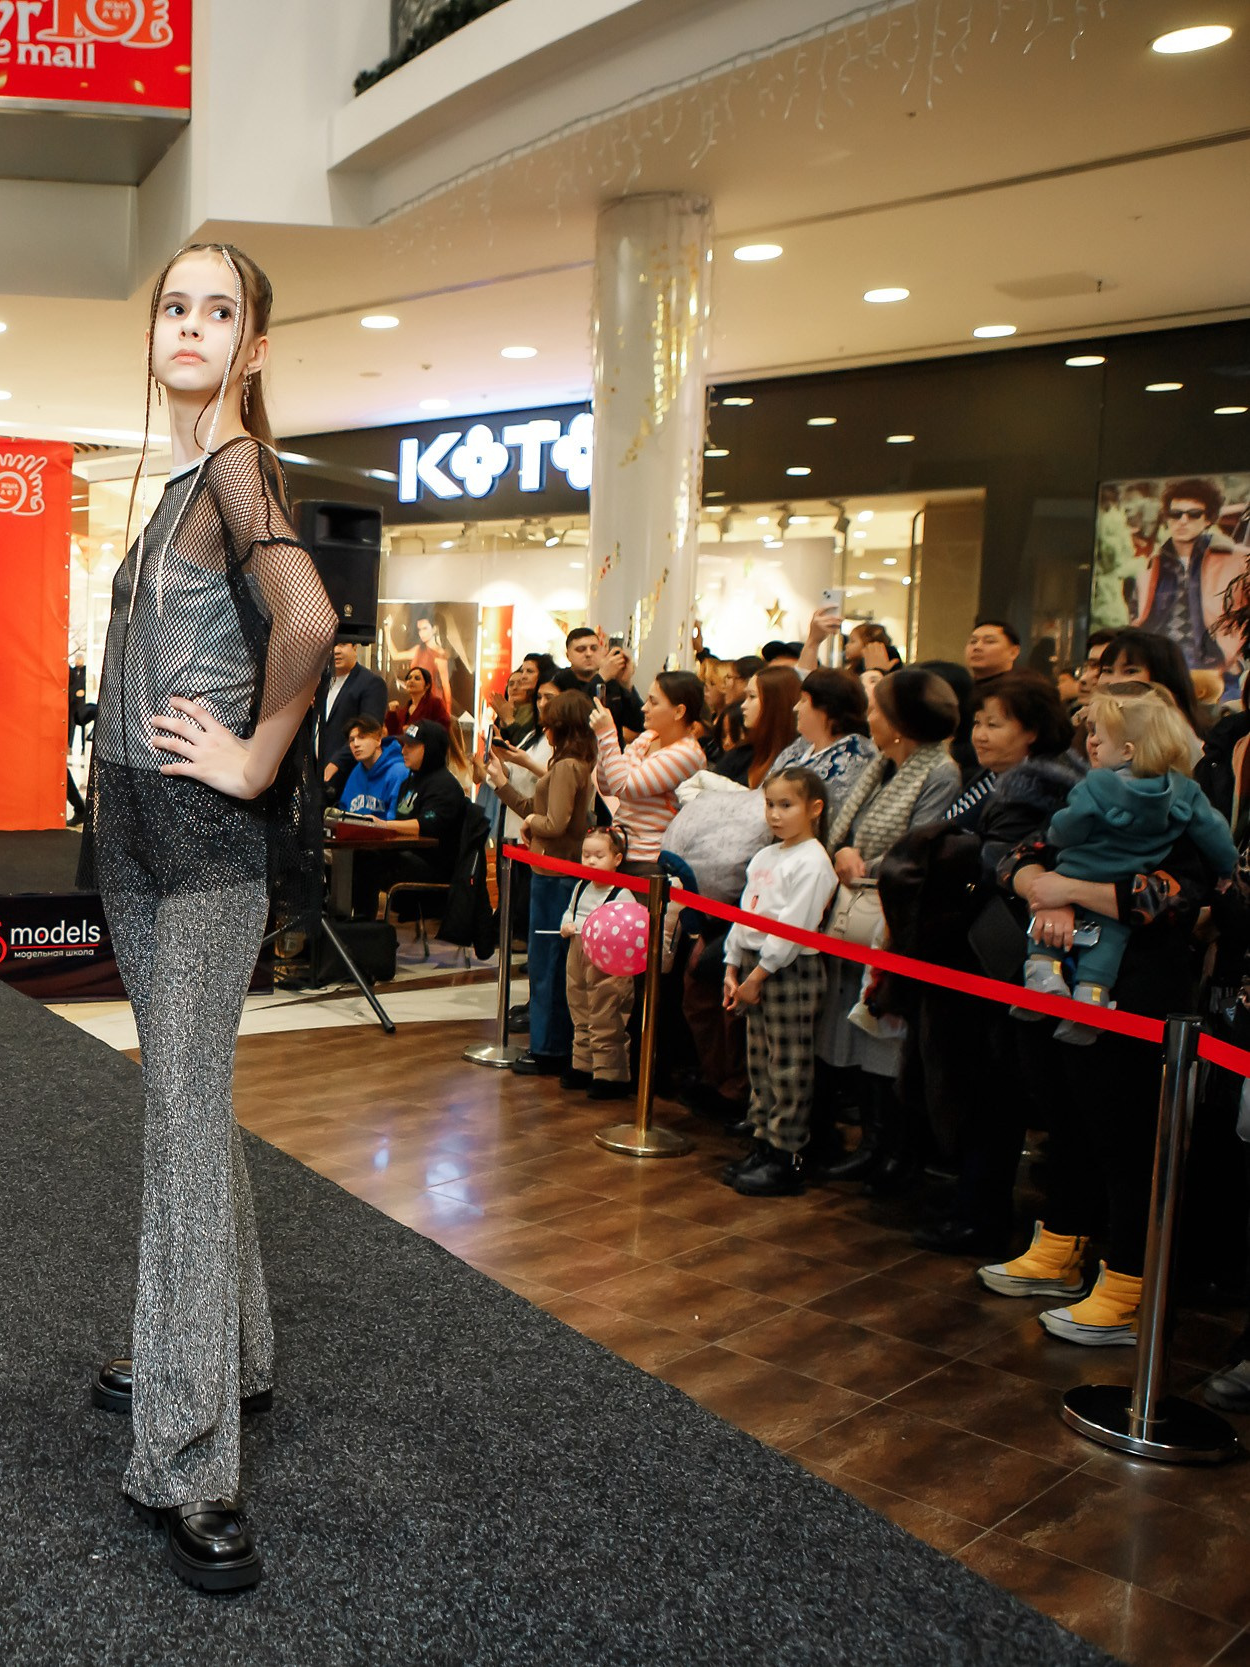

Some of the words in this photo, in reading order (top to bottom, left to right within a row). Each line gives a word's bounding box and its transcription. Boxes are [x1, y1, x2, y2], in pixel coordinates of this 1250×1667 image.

[17, 42, 96, 69] mall
[10, 919, 101, 945] models
[14, 949, 64, 960] модельная
[66, 948, 95, 957] школа
